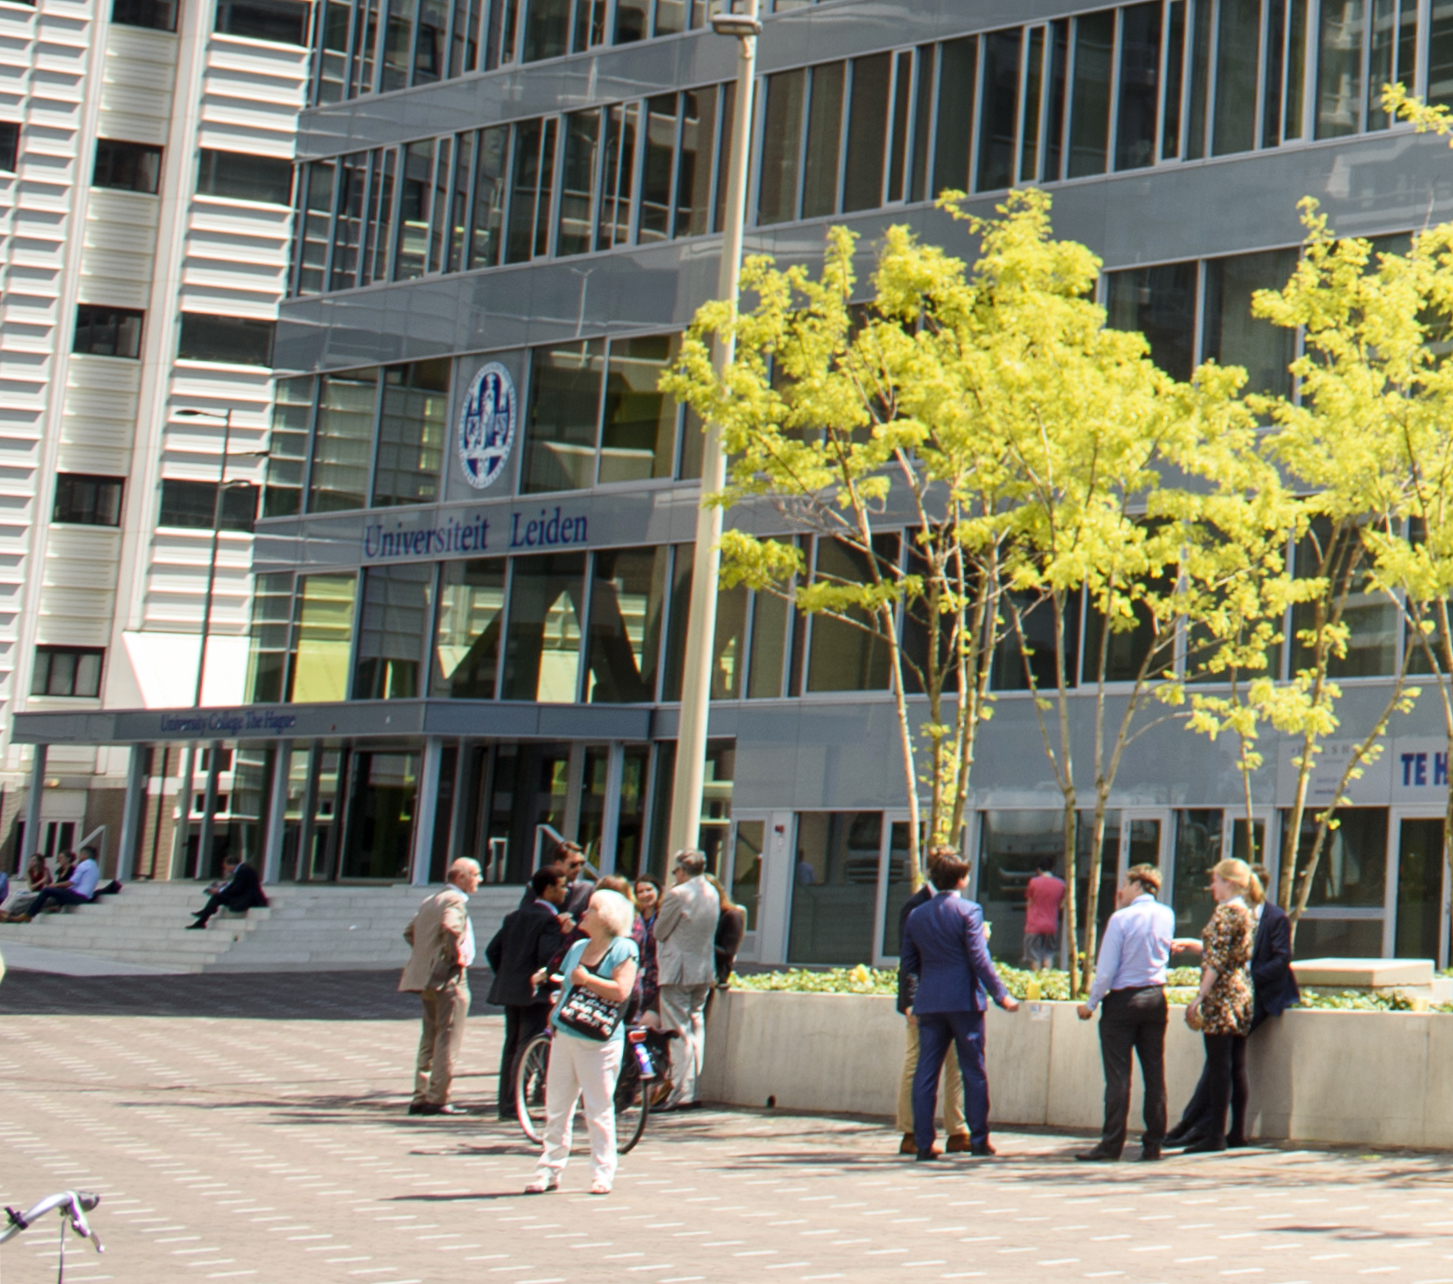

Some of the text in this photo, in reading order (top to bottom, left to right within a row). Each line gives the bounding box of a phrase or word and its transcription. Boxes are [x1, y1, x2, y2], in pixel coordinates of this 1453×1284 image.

[364, 506, 588, 558] Universiteit Leiden
[1401, 752, 1427, 786] TE
